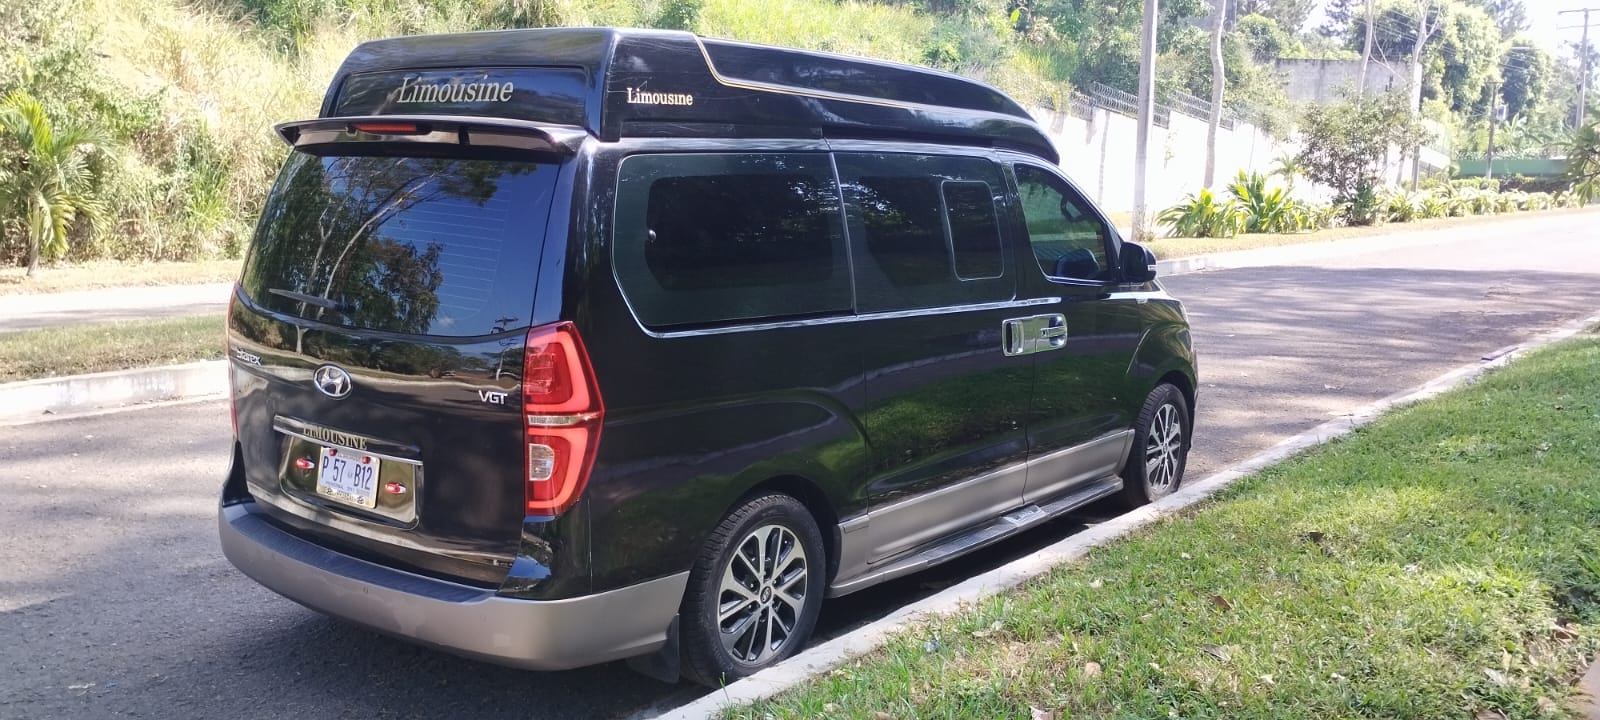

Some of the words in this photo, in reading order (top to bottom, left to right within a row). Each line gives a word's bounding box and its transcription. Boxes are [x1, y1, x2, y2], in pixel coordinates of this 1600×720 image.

[397, 75, 514, 103] Limousine
[627, 87, 693, 106] Limousine
[478, 389, 508, 405] VGT
[303, 425, 367, 451] LIMOUSINE
[321, 455, 329, 479] P
[332, 458, 346, 483] 57
[353, 463, 373, 490] B12
